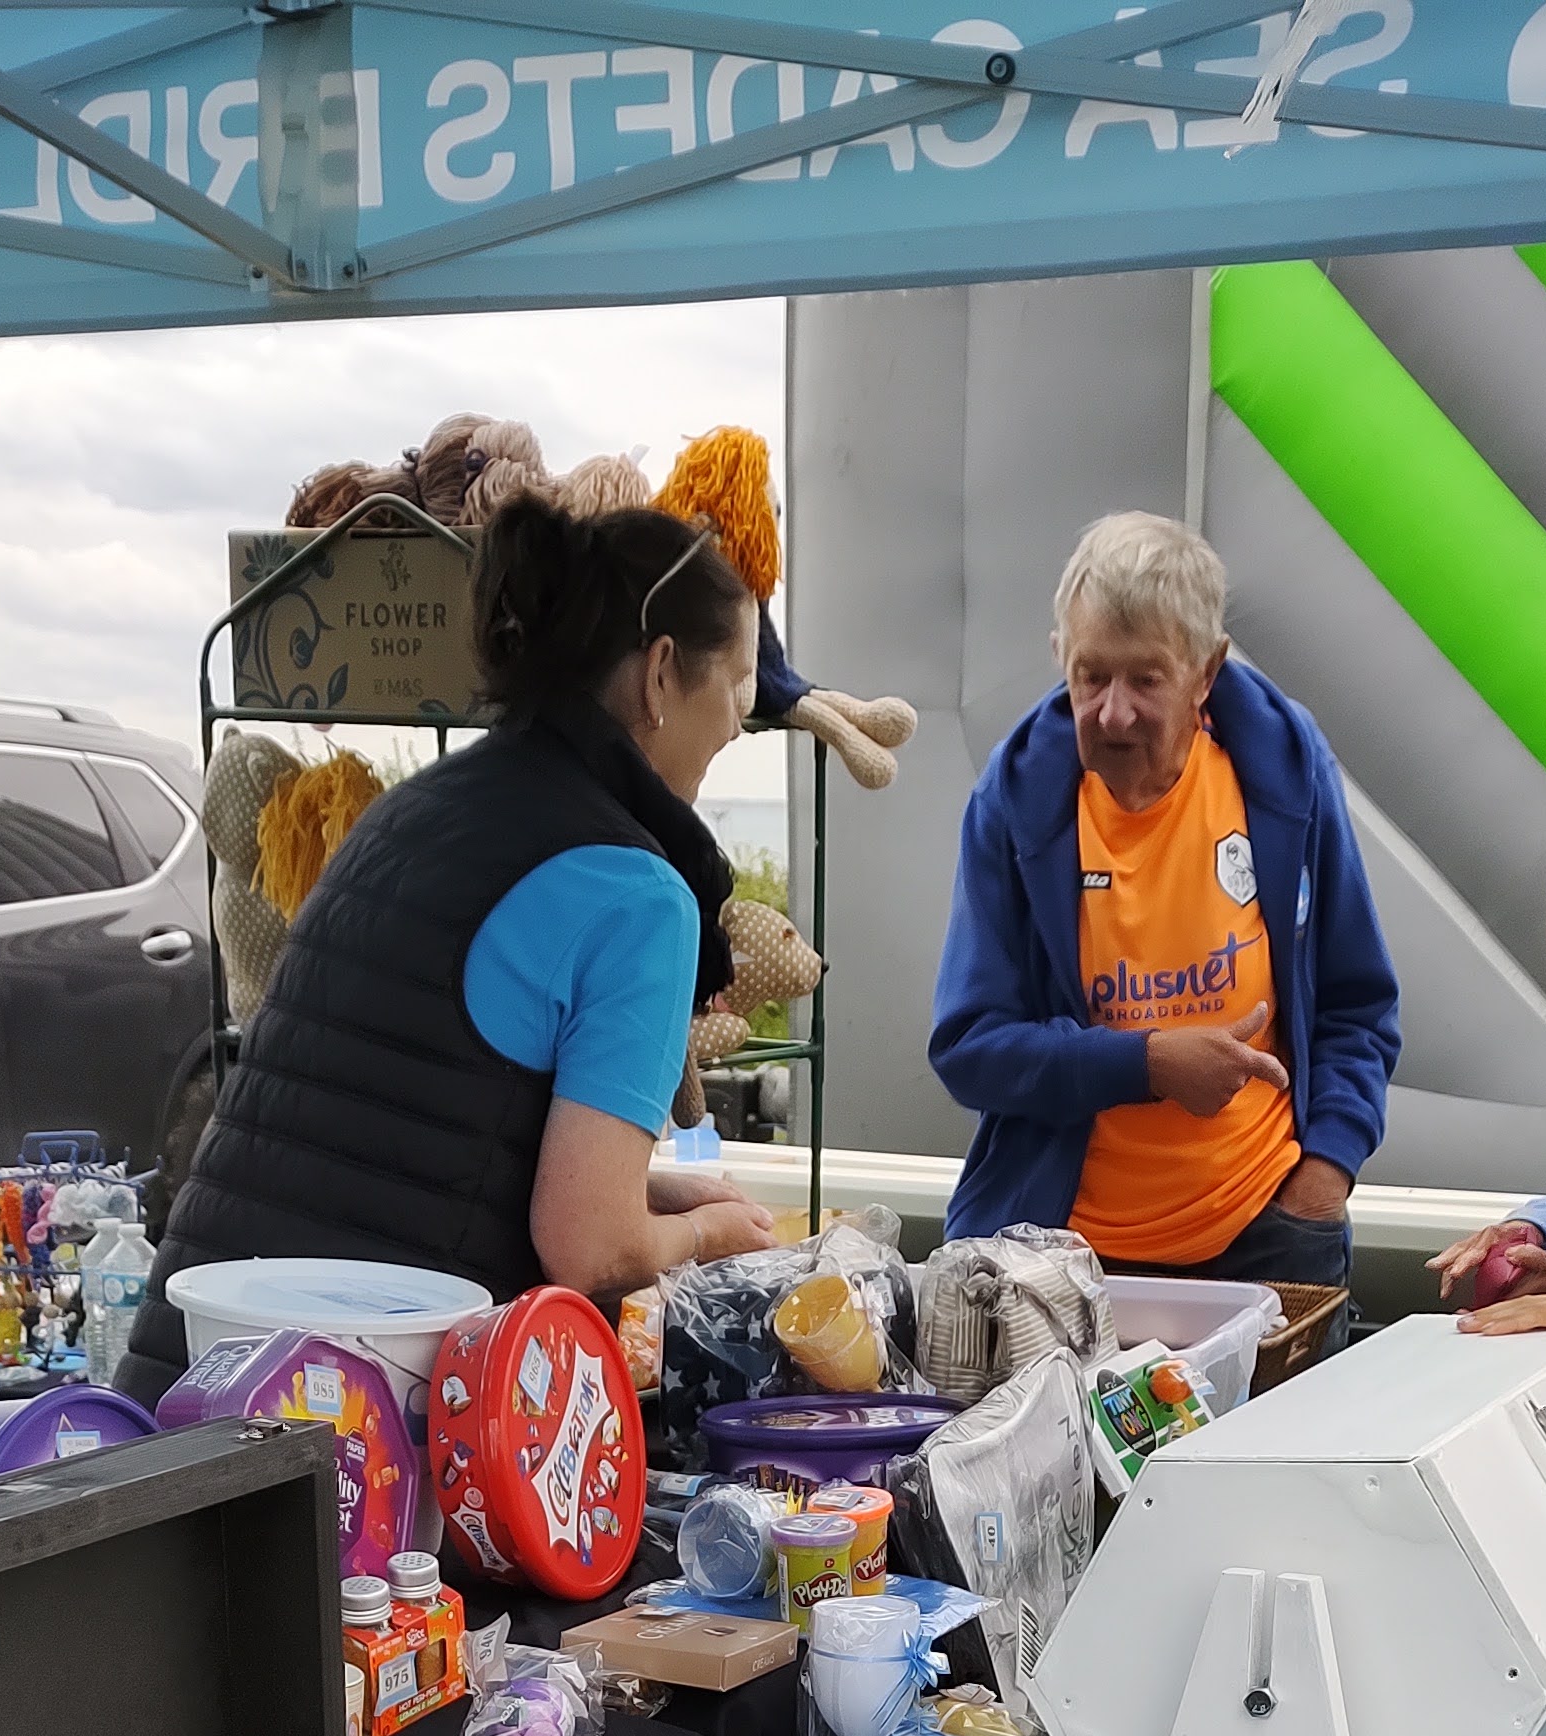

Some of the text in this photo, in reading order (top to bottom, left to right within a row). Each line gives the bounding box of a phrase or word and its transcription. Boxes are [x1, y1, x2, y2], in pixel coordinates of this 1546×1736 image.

[345, 602, 447, 628] FLOWER
[370, 637, 423, 657] SHOP
[1091, 931, 1264, 1014] plusnet
[1104, 998, 1226, 1022] BROADBAND
[313, 1381, 335, 1399] 985
[986, 1525, 996, 1548] 40
[793, 1576, 848, 1605] Play-Do
[479, 1630, 496, 1661] 940
[384, 1667, 410, 1693] 975
